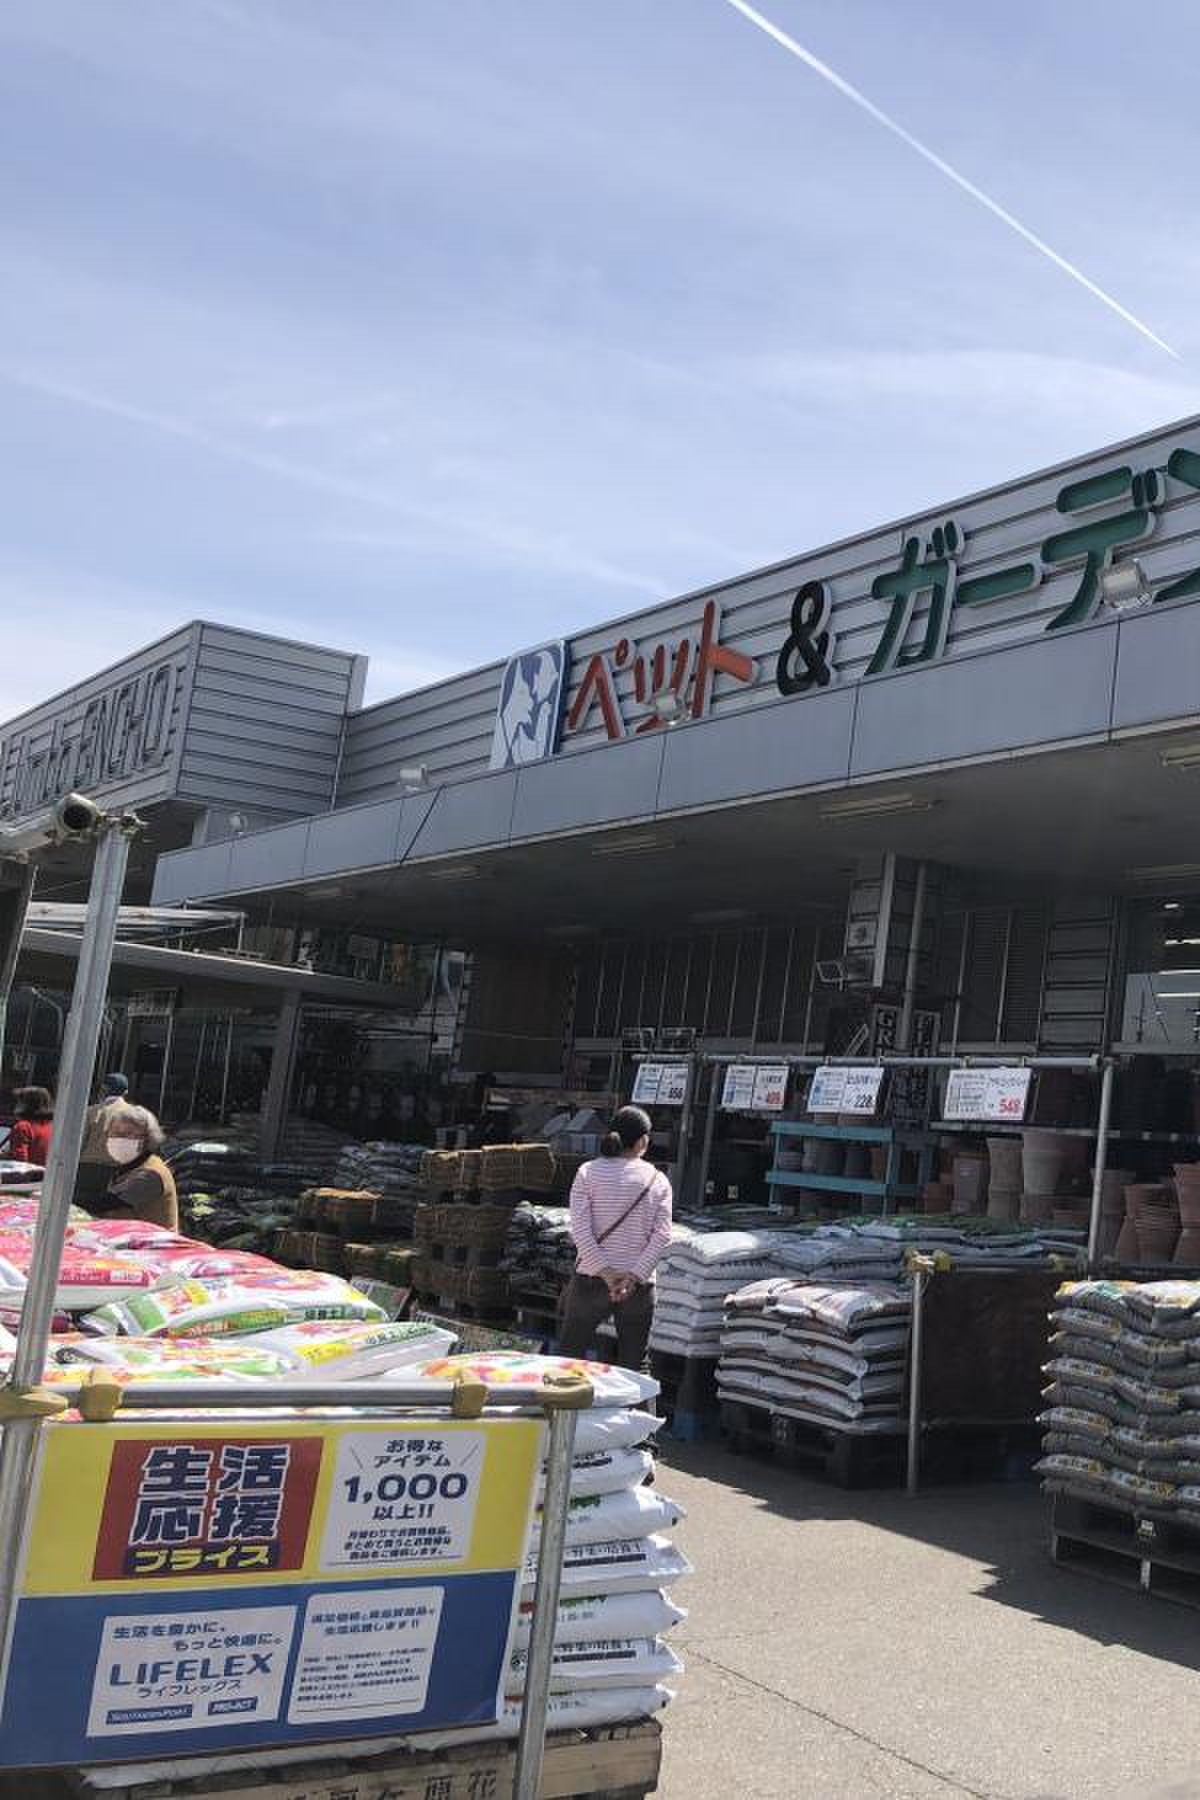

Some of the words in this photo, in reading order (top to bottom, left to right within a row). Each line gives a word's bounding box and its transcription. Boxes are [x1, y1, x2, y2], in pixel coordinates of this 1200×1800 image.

[385, 1439, 445, 1453] お得な
[139, 1443, 290, 1496] 生活
[373, 1453, 452, 1469] アイテム
[343, 1472, 469, 1505] 1,000
[127, 1491, 284, 1546] 応援
[372, 1503, 435, 1520] 以上!!
[134, 1545, 270, 1573] プライス
[109, 1652, 274, 1686] LIFELEX
[137, 1679, 242, 1699] ライフレックス
